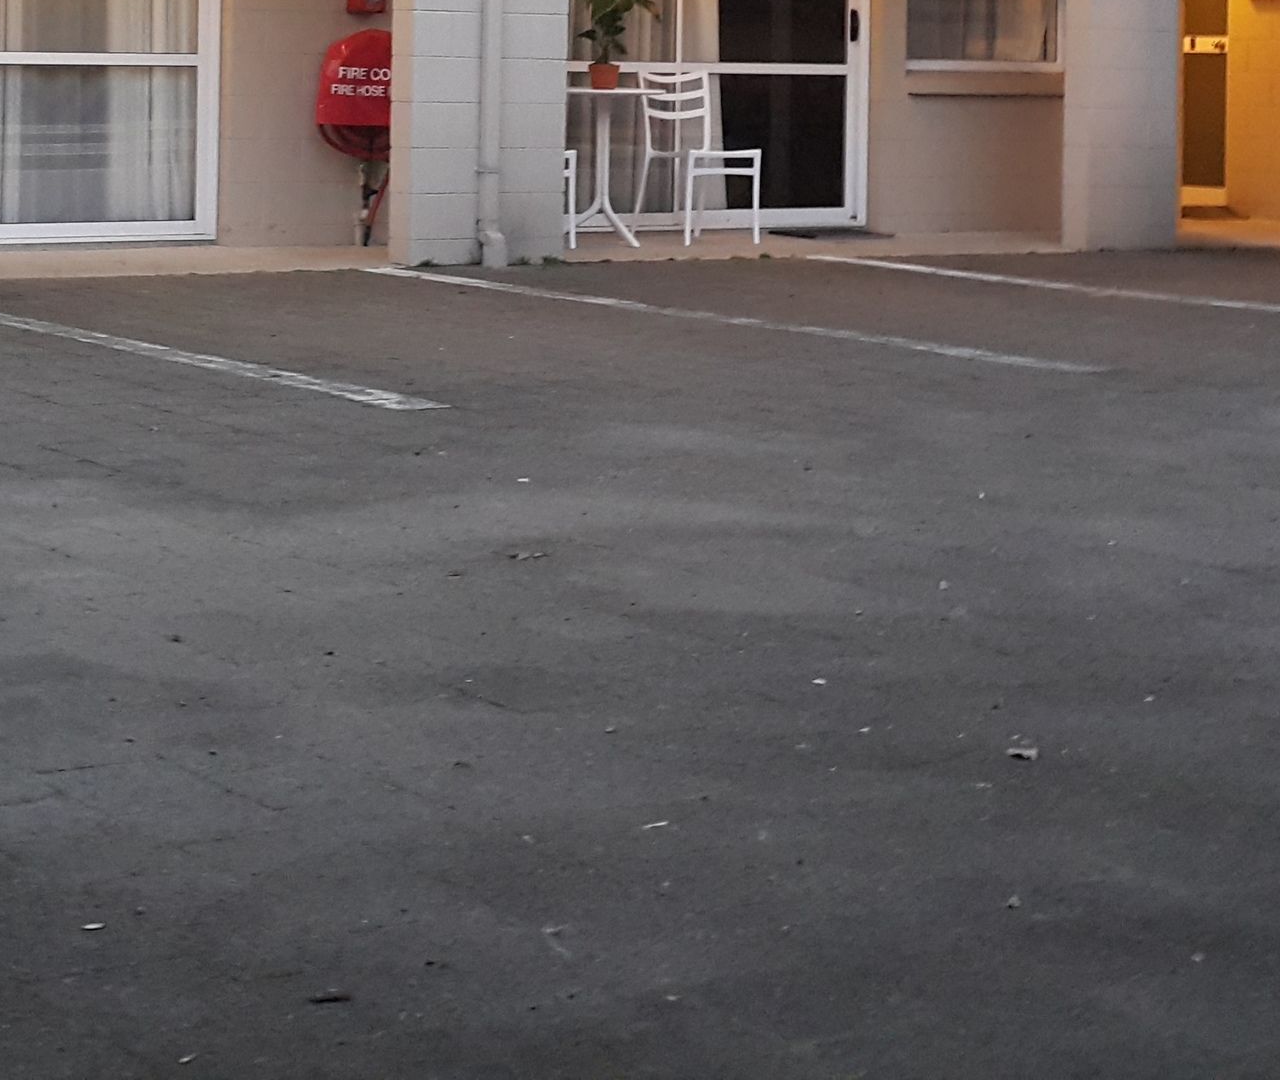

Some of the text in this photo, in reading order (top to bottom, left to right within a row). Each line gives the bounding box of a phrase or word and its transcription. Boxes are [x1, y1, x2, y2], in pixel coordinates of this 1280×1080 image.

[338, 66, 369, 80] FIRE
[331, 83, 356, 96] FIRE
[356, 84, 386, 97] HOSE
